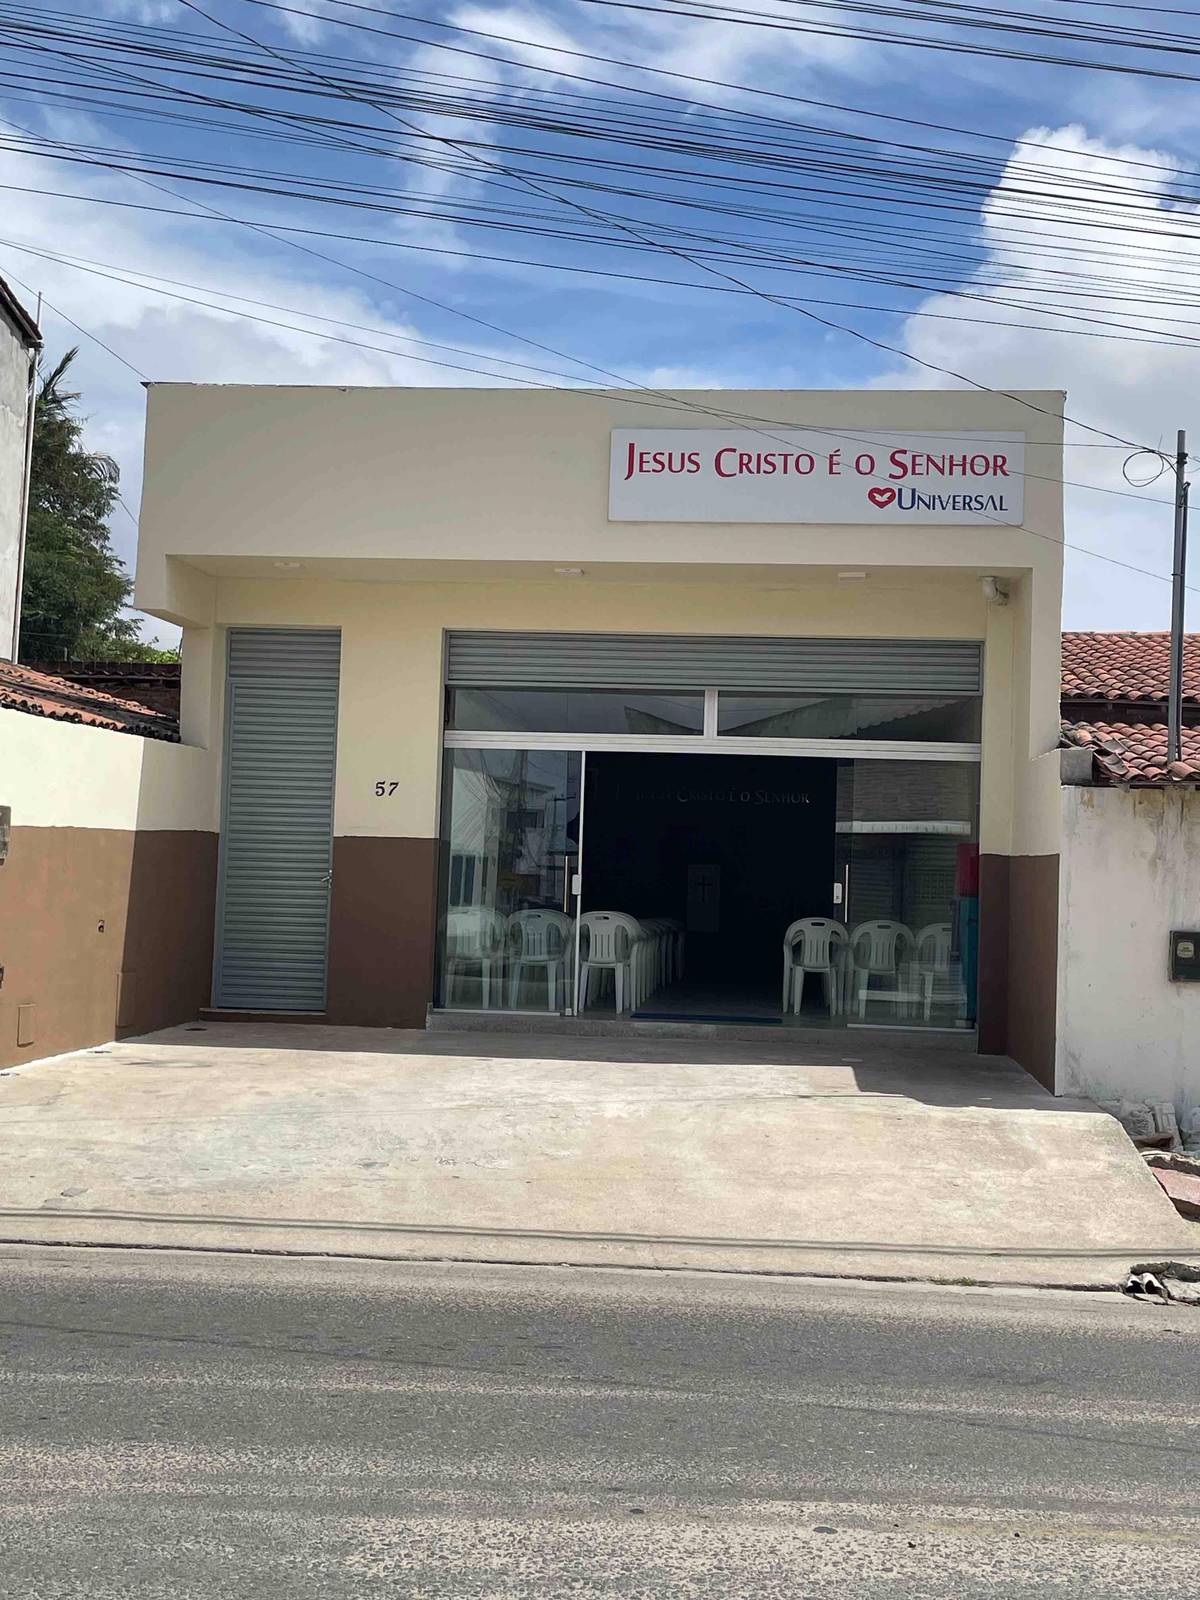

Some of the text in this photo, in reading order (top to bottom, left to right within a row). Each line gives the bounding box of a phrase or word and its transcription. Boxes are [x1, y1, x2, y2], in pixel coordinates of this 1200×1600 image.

[624, 443, 1010, 480] JESUS CRISTO É O SENHOR
[897, 488, 1008, 511] UNIVERSAL
[375, 780, 399, 797] 57
